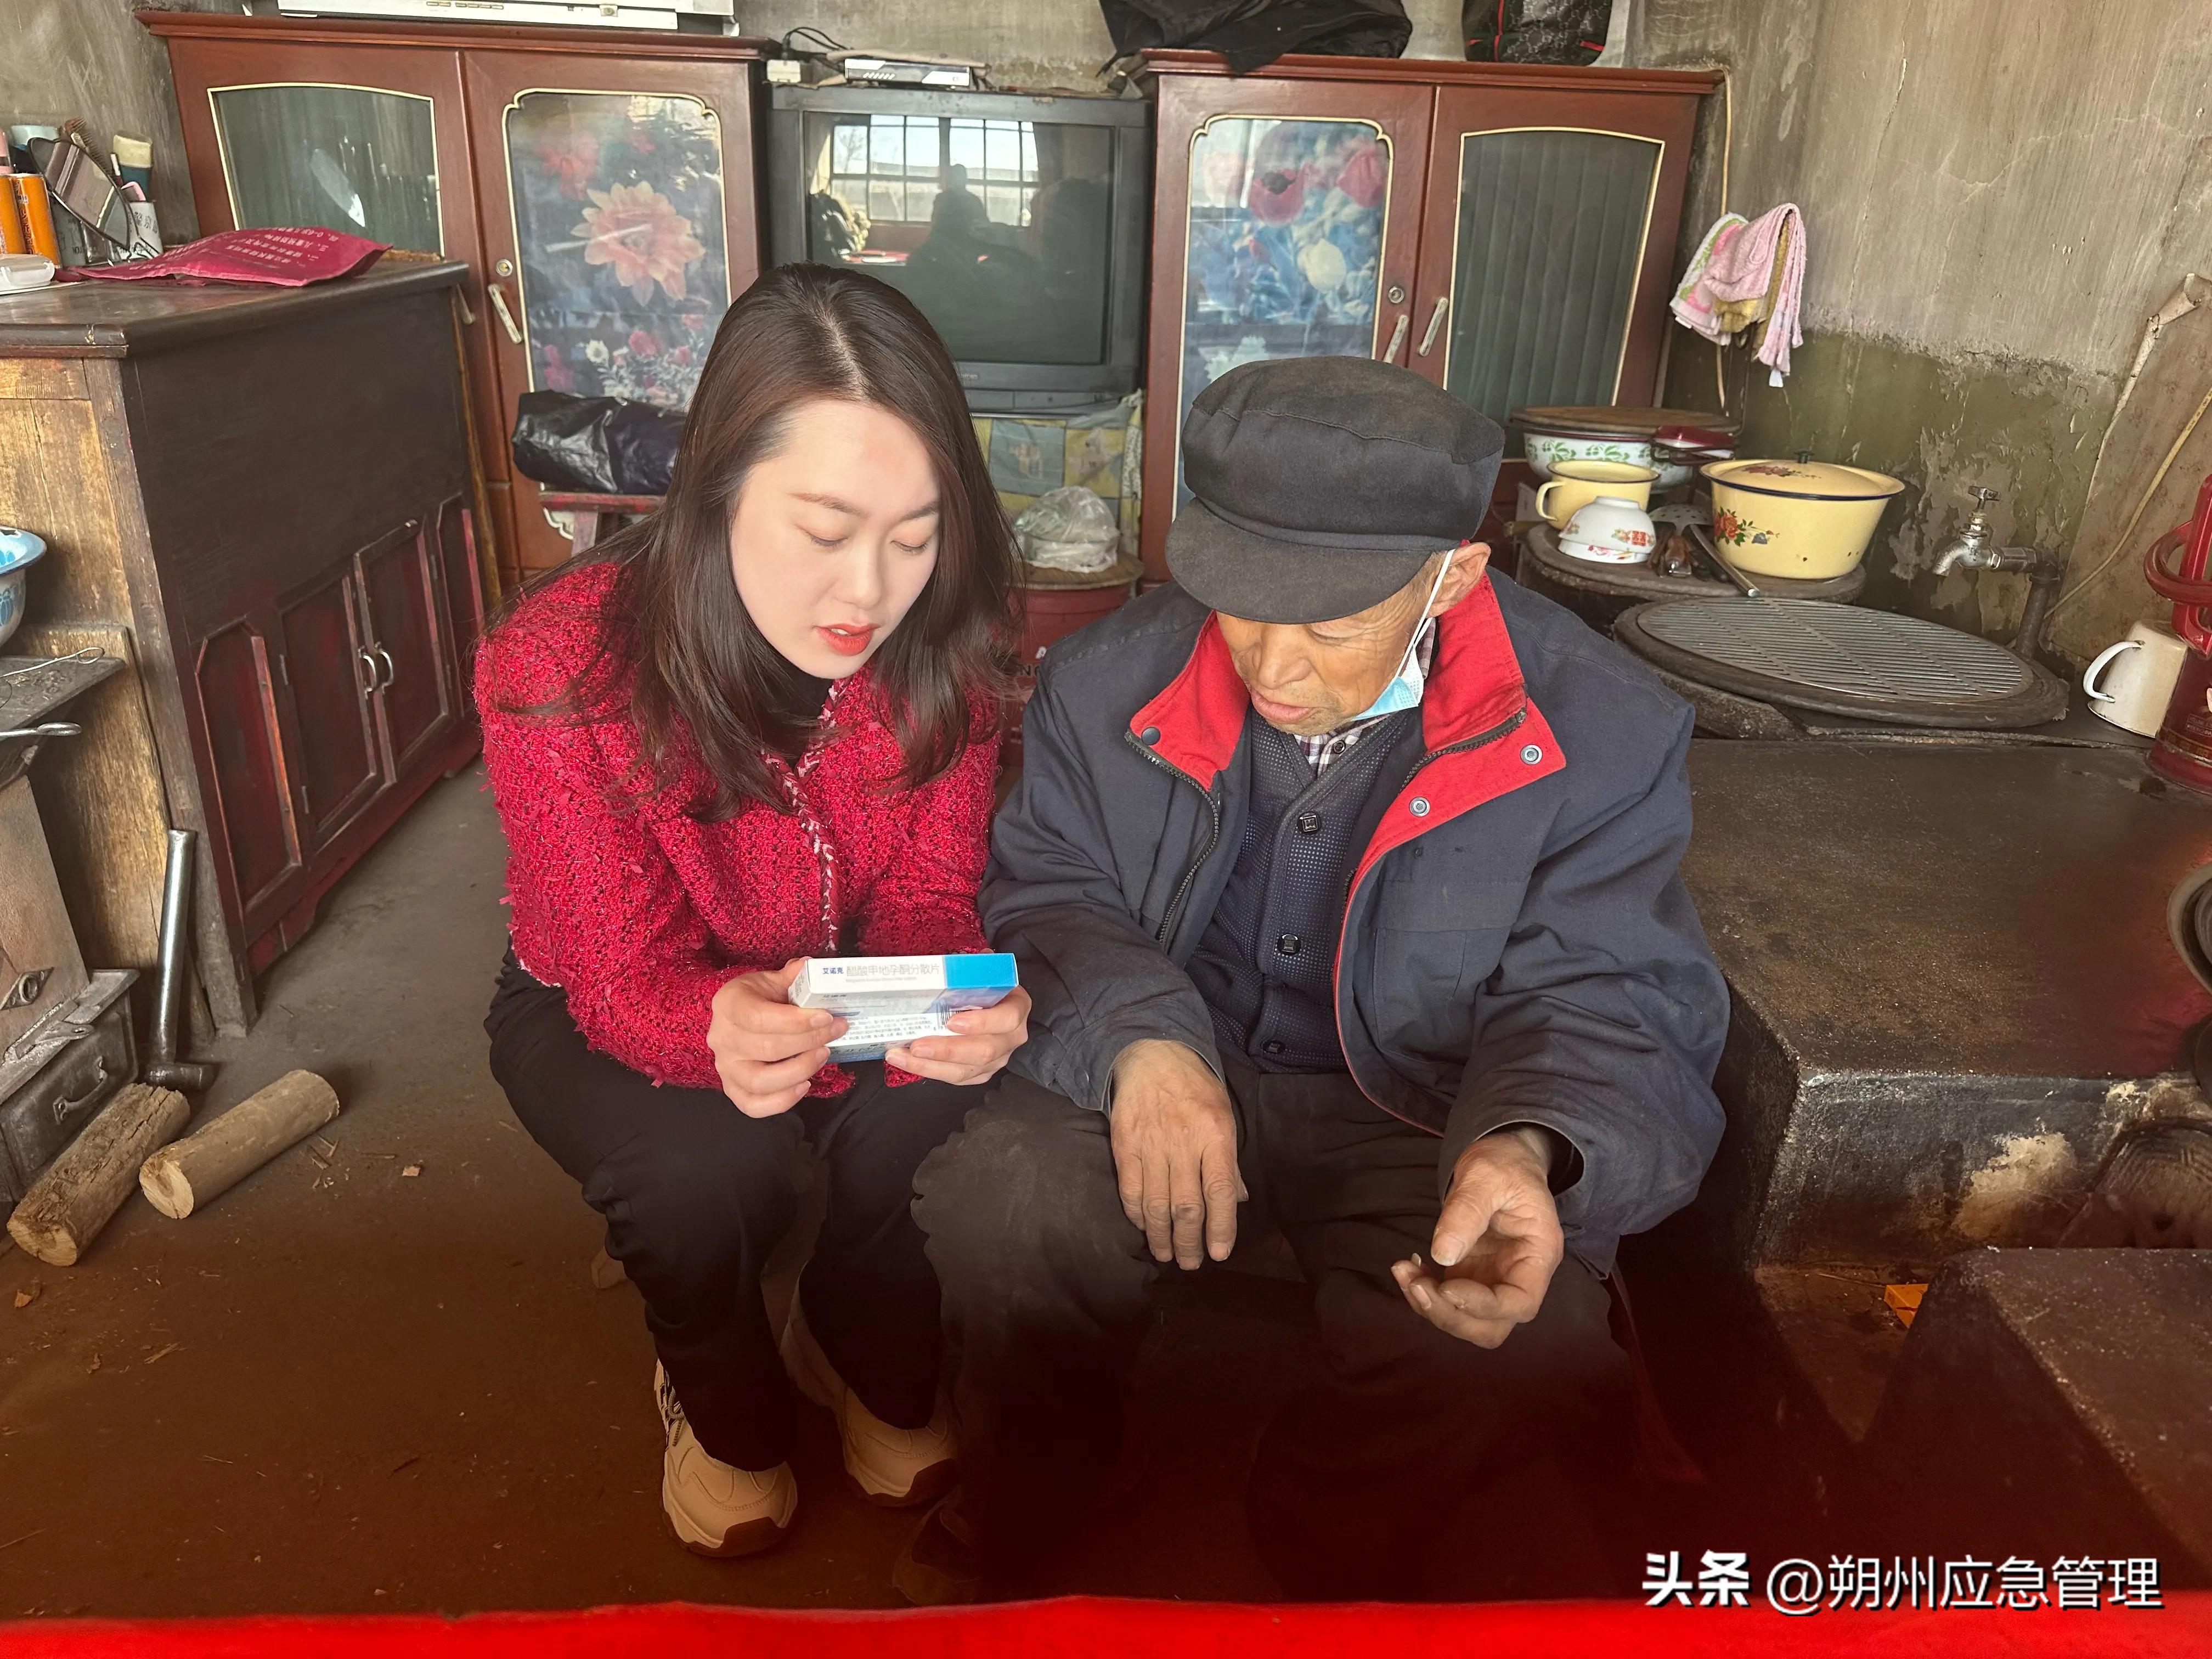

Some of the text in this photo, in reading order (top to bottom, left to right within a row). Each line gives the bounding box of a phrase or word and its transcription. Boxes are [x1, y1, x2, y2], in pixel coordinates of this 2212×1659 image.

[847, 963, 940, 977] 醋酸甲地孕酮分散片
